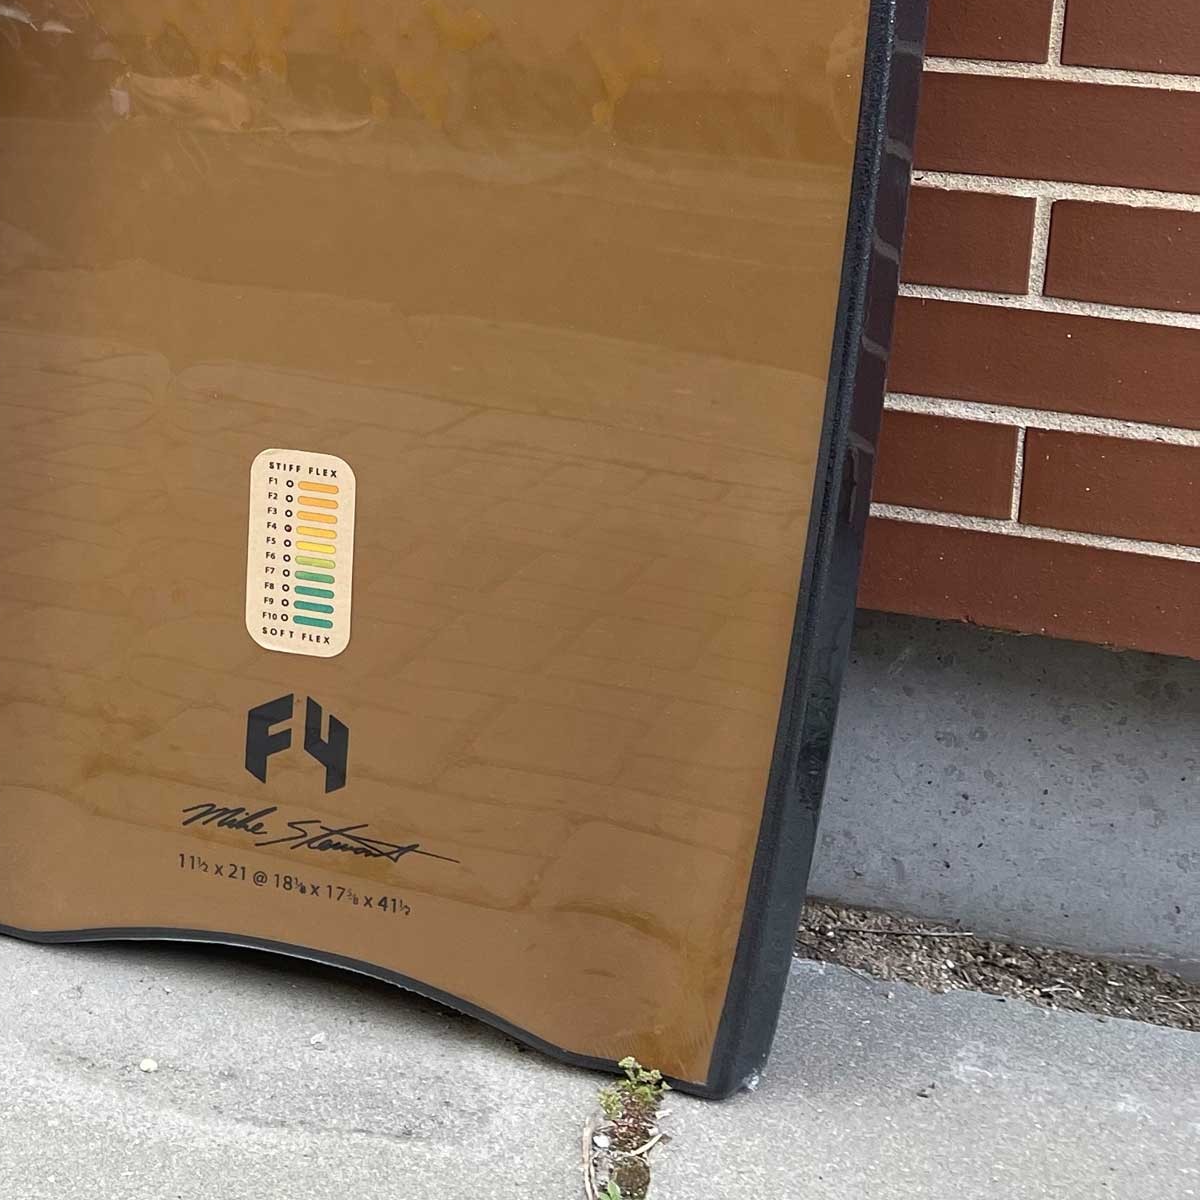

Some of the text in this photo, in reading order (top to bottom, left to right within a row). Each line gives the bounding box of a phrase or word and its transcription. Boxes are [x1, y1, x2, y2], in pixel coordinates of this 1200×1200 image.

[269, 461, 337, 478] STIFF FLEX
[268, 477, 278, 485] F1
[268, 492, 278, 500] F2
[267, 507, 277, 515] F3
[266, 521, 277, 530] F4
[266, 536, 276, 545] F5
[265, 551, 276, 560] F6
[265, 566, 275, 575] F7
[264, 581, 275, 590] F8
[263, 596, 274, 605] F9
[262, 611, 277, 621] F10
[262, 627, 330, 644] SOFT FLEX
[245, 693, 349, 794] F4
[182, 803, 277, 835] Mike
[214, 863, 224, 876] x
[228, 863, 246, 880] 21
[253, 871, 268, 886] @
[310, 883, 320, 896] x
[363, 895, 373, 908] x
